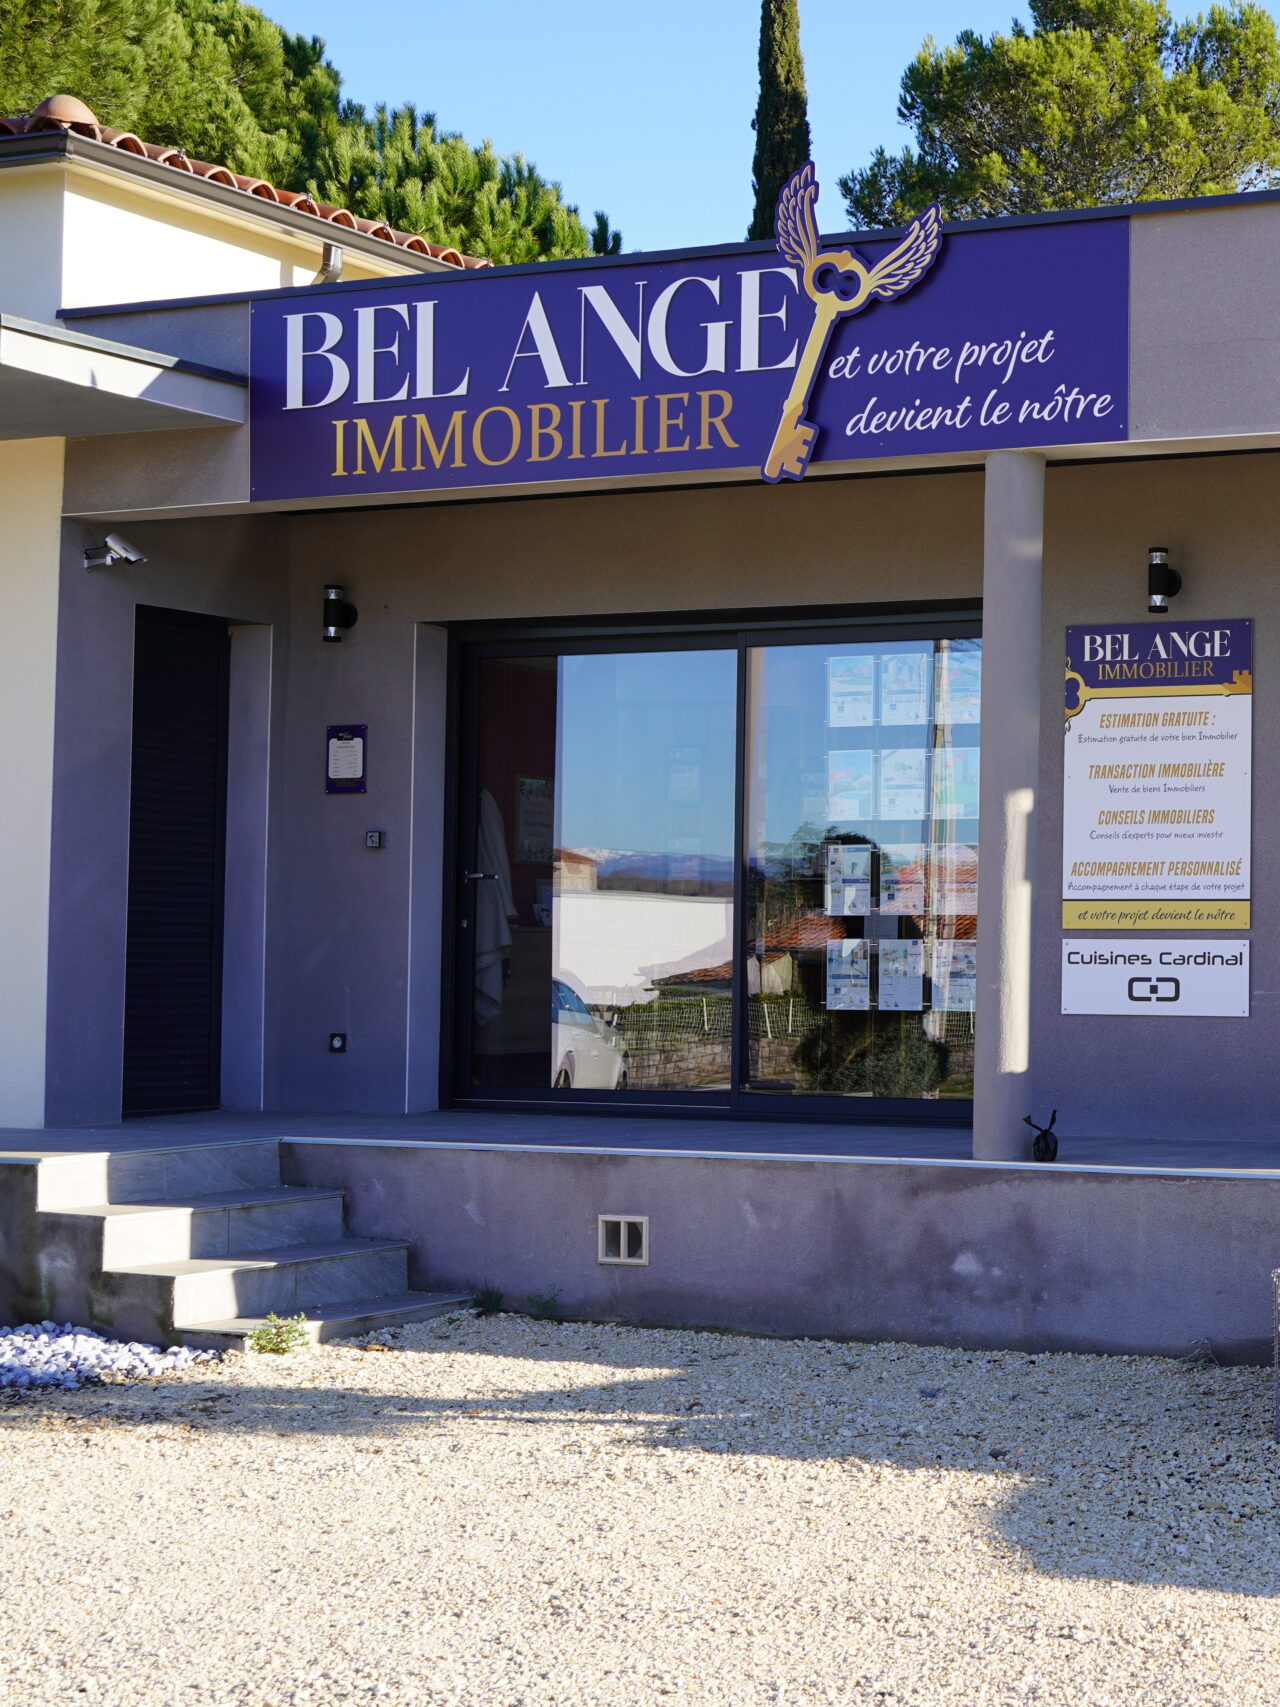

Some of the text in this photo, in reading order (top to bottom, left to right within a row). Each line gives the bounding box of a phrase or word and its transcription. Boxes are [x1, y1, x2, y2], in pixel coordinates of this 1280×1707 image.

[282, 267, 799, 410] BEL ANGE
[828, 329, 1055, 384] et votre projet
[845, 384, 1115, 436] devient le nôtre
[331, 390, 740, 476] IMMOBILIER
[1083, 630, 1231, 662] BEL ANGE
[1097, 661, 1215, 680] IMMOBILIER
[1100, 713, 1159, 729] ESTIMATION
[1162, 712, 1210, 727] GRATUITE
[1078, 731, 1238, 744] Estimation gratuite de votre bien Immobilier
[1089, 759, 1225, 779] TRANSACTION IMMOBILIÈRE
[1108, 783, 1206, 793] Vente de biens Immobiliers
[1098, 809, 1215, 825] CONSEILS IMMOBILIERS
[1089, 830, 1223, 841] Conseils d'experts pour mieux investir
[1070, 858, 1242, 876] ACCOMPAGNEMENT PERSONNALISÉ
[1067, 881, 1245, 893] Accompagnement à chaque étape de votre projet
[1078, 907, 1236, 925] et votre projet devient le nôtre
[1067, 951, 1243, 966] Cuisines Cardinal
